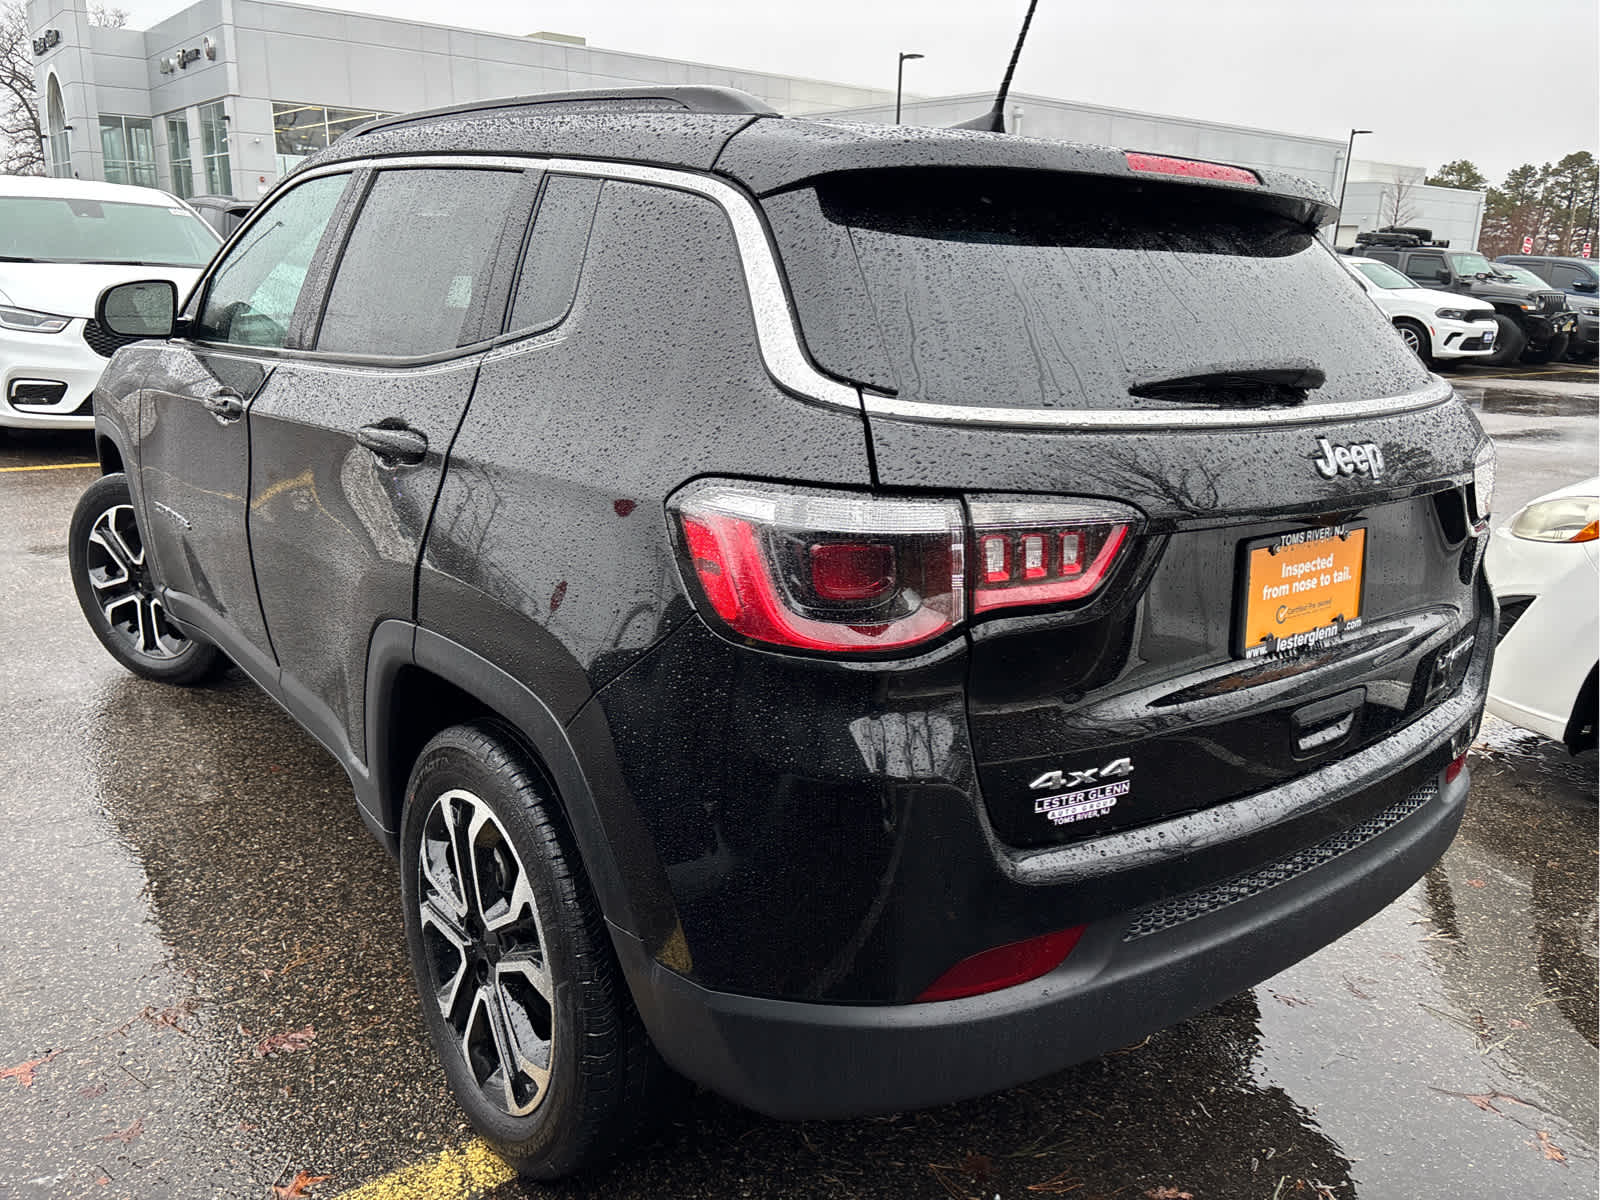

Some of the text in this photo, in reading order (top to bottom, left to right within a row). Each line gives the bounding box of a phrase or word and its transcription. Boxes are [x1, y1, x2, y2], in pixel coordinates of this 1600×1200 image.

[1315, 437, 1384, 483] Jeep
[1280, 531, 1305, 546] TOMS
[1281, 553, 1334, 578] Inspected
[1262, 566, 1352, 601] from nose to tail.
[1029, 757, 1135, 790] 4x4
[1034, 782, 1131, 812] LESTER GLENN
[1050, 799, 1115, 818] AUTO GROUP
[1053, 815, 1075, 826] TOMS
[1100, 807, 1111, 816] NJ
